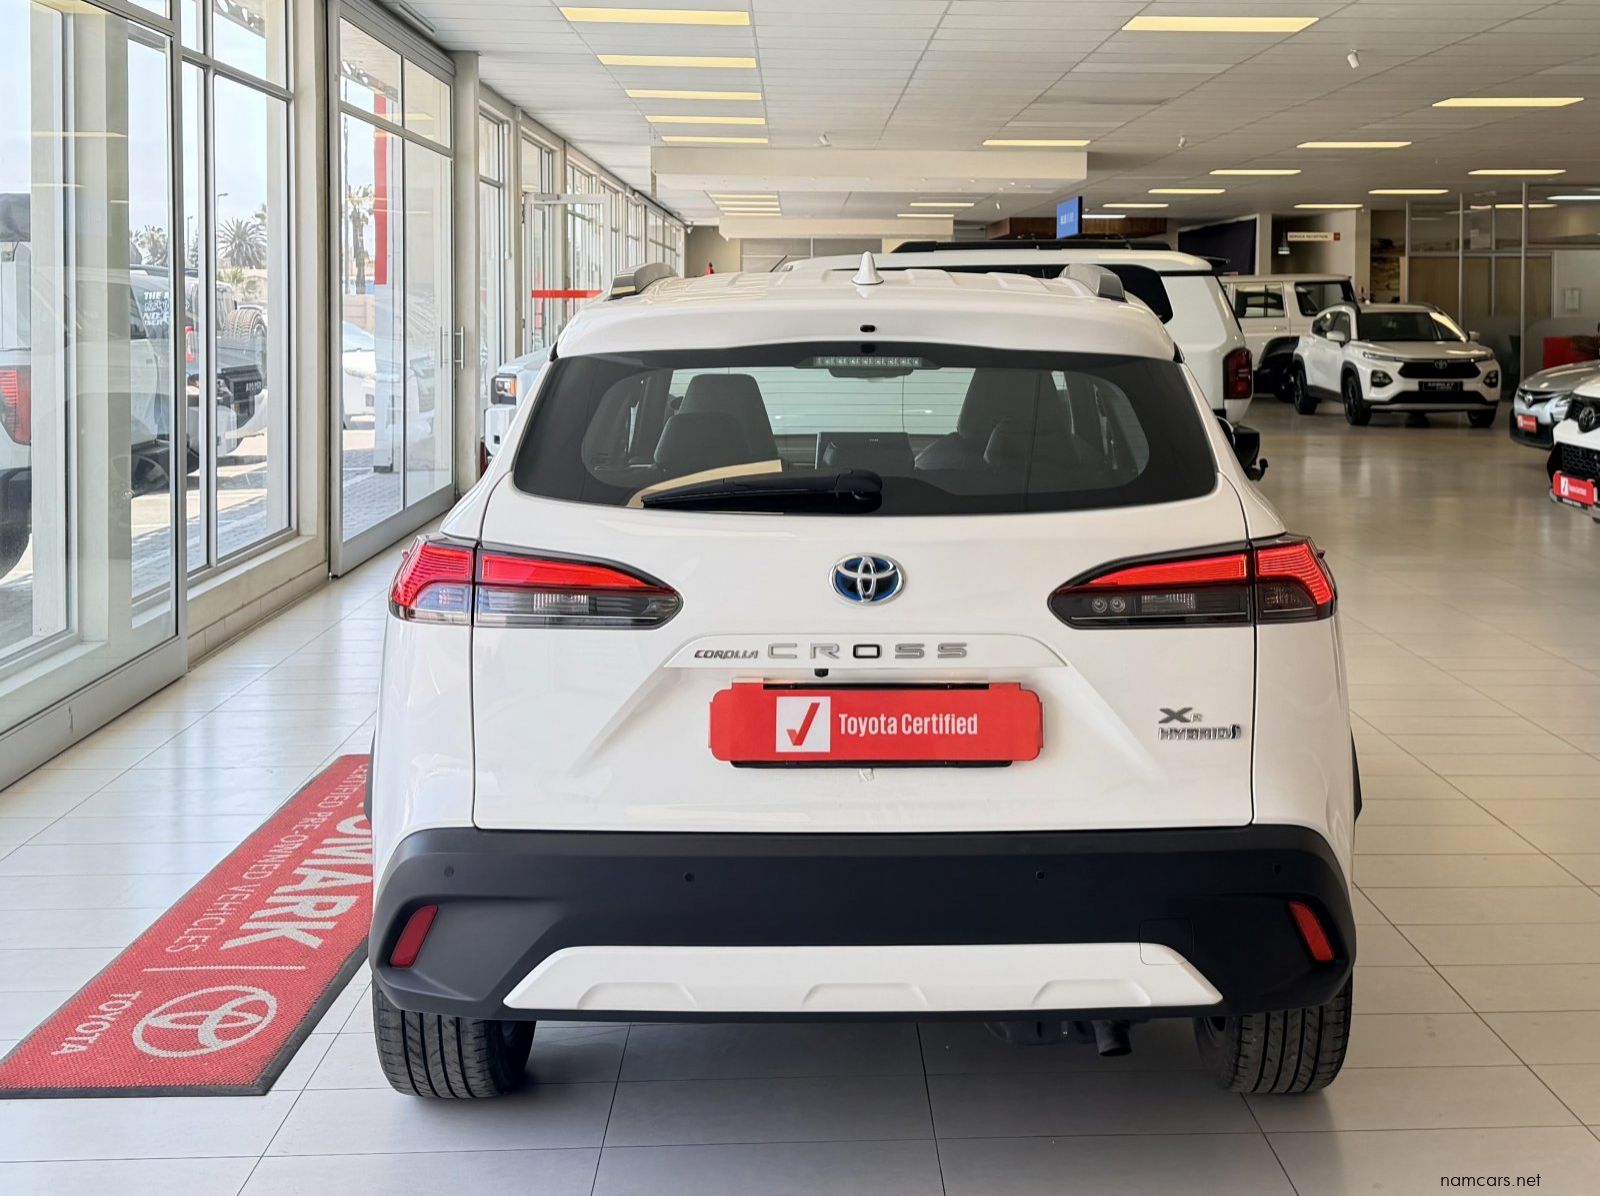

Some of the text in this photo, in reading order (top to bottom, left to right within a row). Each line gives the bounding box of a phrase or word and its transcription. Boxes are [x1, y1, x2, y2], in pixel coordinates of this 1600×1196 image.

[694, 643, 968, 660] COROLLA CROSS
[838, 712, 978, 737] Toyota Certified
[1159, 727, 1231, 740] HYBRID
[219, 802, 374, 950] OMARK
[243, 811, 334, 880] PRE-OWNED
[166, 883, 261, 952] VEHICLES
[51, 990, 143, 1056] TOYOTA
